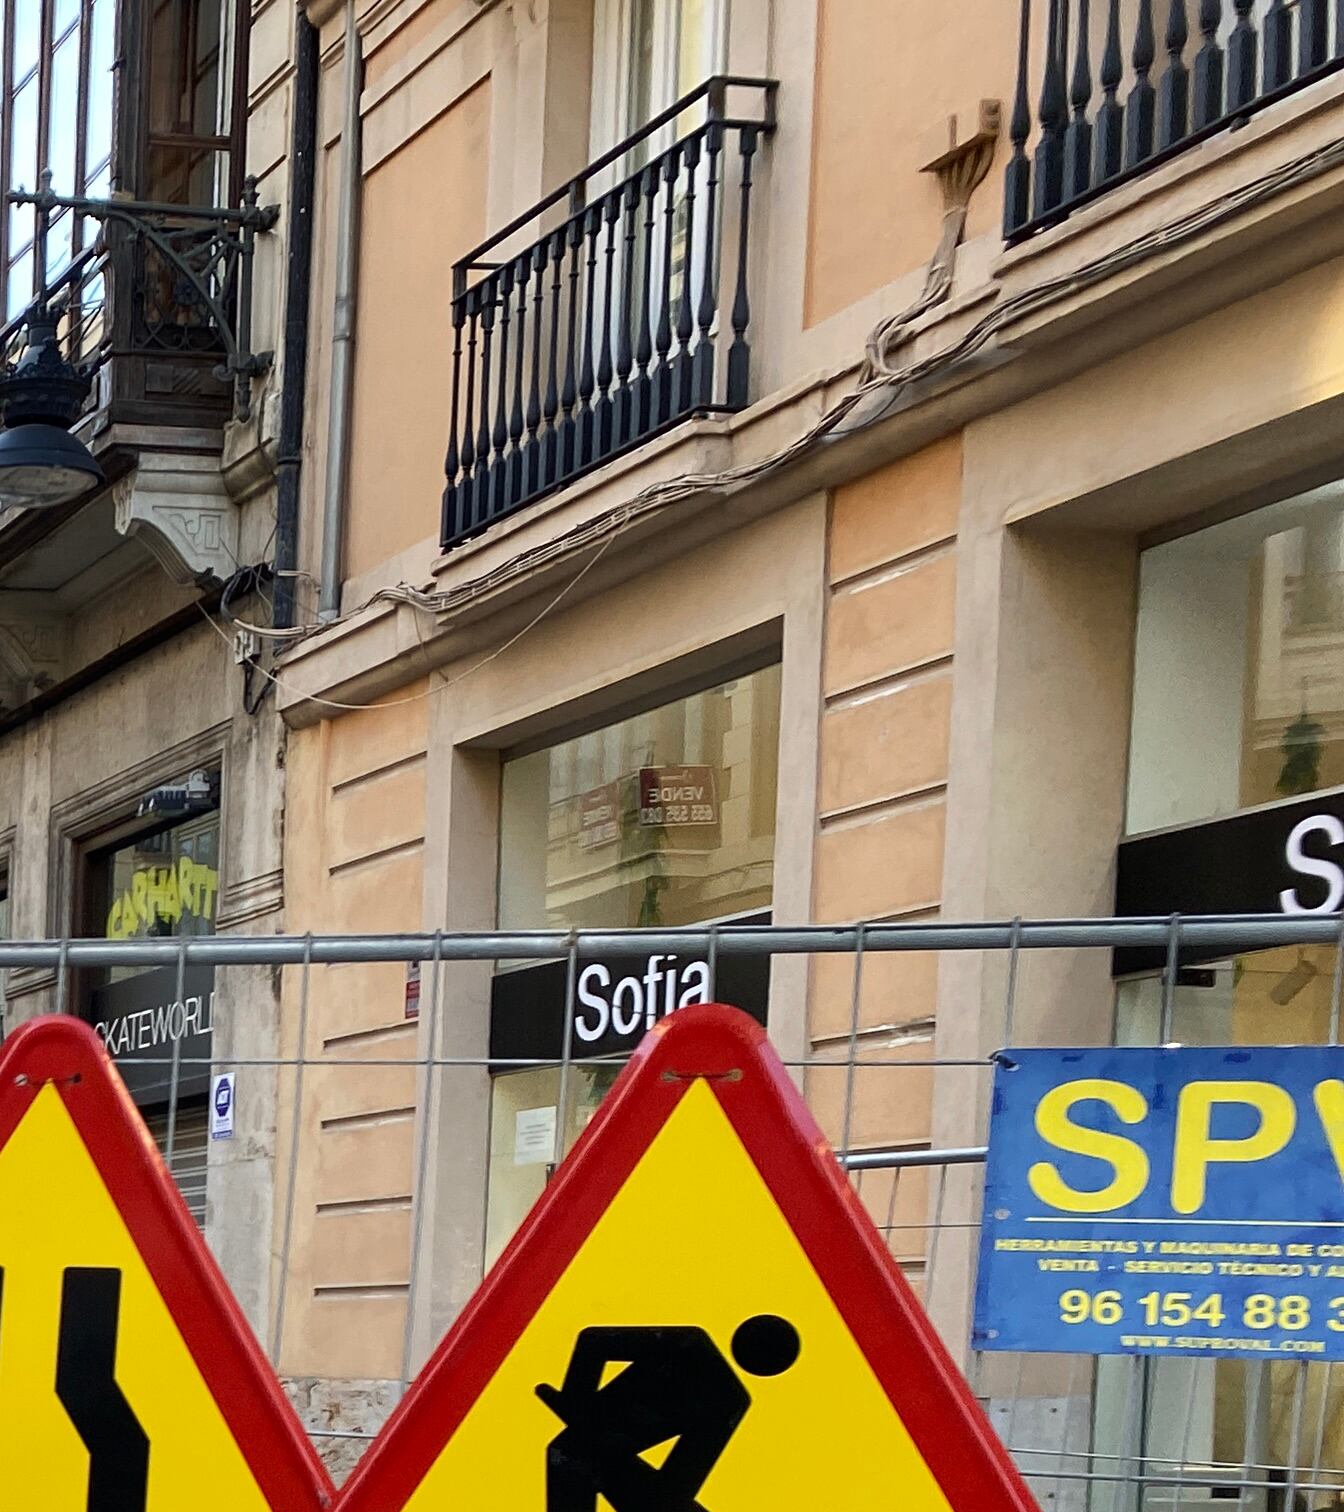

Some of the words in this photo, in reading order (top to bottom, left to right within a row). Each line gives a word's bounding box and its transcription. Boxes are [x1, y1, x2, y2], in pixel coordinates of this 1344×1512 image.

[575, 955, 710, 1041] Sofia
[95, 992, 215, 1055] KATEWORL
[1038, 1259, 1100, 1272] VENTA
[1307, 1264, 1322, 1277] Y
[1142, 1242, 1158, 1254] Y
[1286, 1243, 1314, 1257] DE
[1059, 1289, 1124, 1326] 96
[1137, 1291, 1226, 1328] 154
[1242, 1293, 1311, 1331] 88
